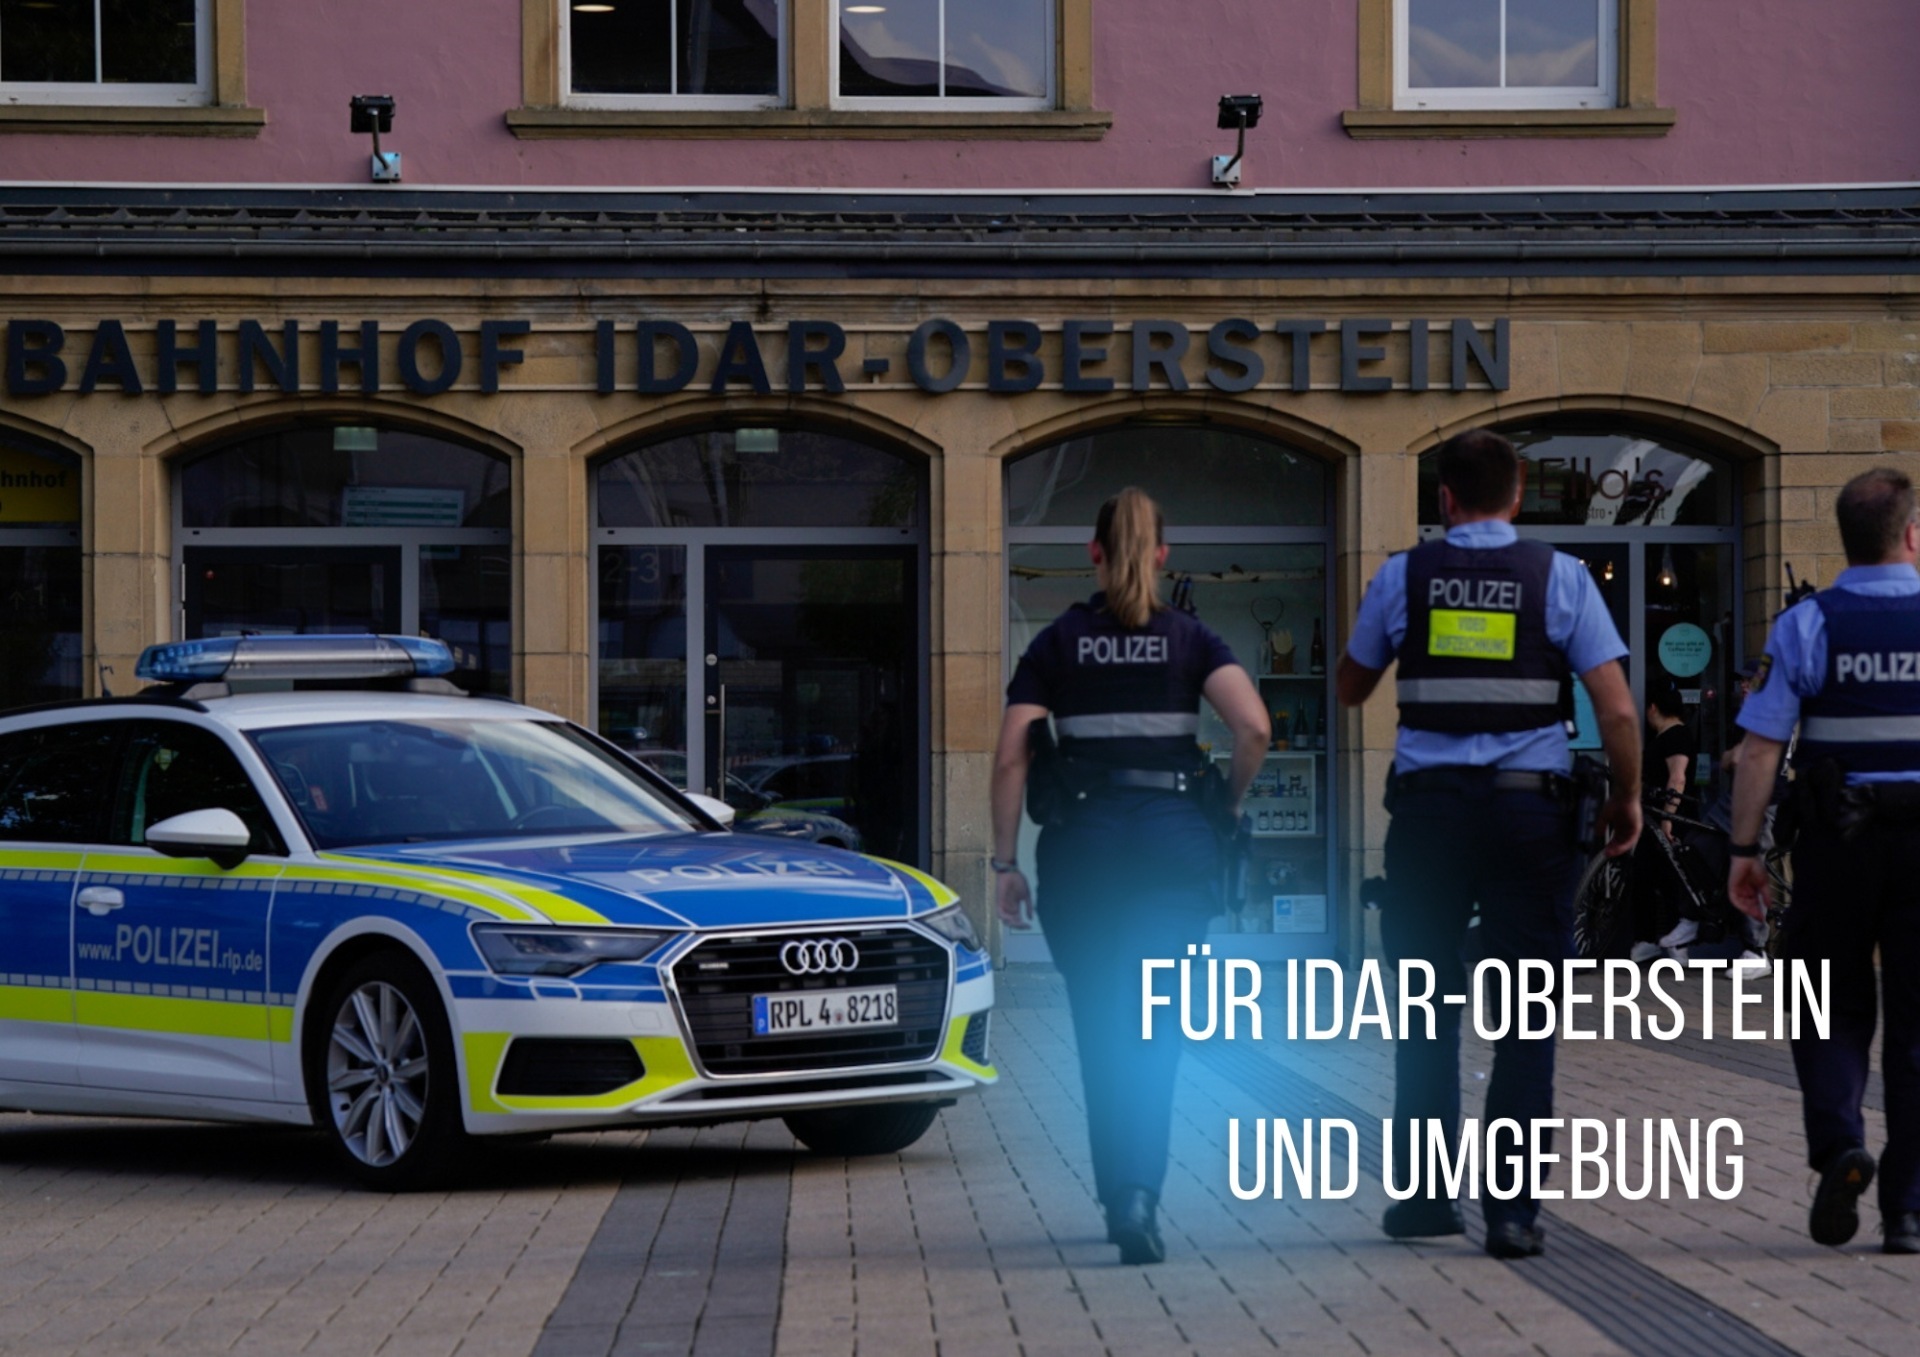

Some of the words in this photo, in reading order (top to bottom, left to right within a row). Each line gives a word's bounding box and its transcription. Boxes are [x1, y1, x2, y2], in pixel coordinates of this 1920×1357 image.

[7, 320, 530, 396] BAHNHOF
[596, 318, 1510, 395] IDAR-OBERSTEIN
[1539, 457, 1665, 500] Ella's
[603, 552, 660, 583] 2-3
[1429, 578, 1522, 610] POLIZEI
[1078, 635, 1168, 664] POLIZEI
[625, 860, 856, 884] POLIZEI
[77, 923, 263, 975] www.POLIZEI.rlp.de
[770, 999, 813, 1029] RPL
[819, 998, 831, 1026] 4
[847, 992, 896, 1023] 8218
